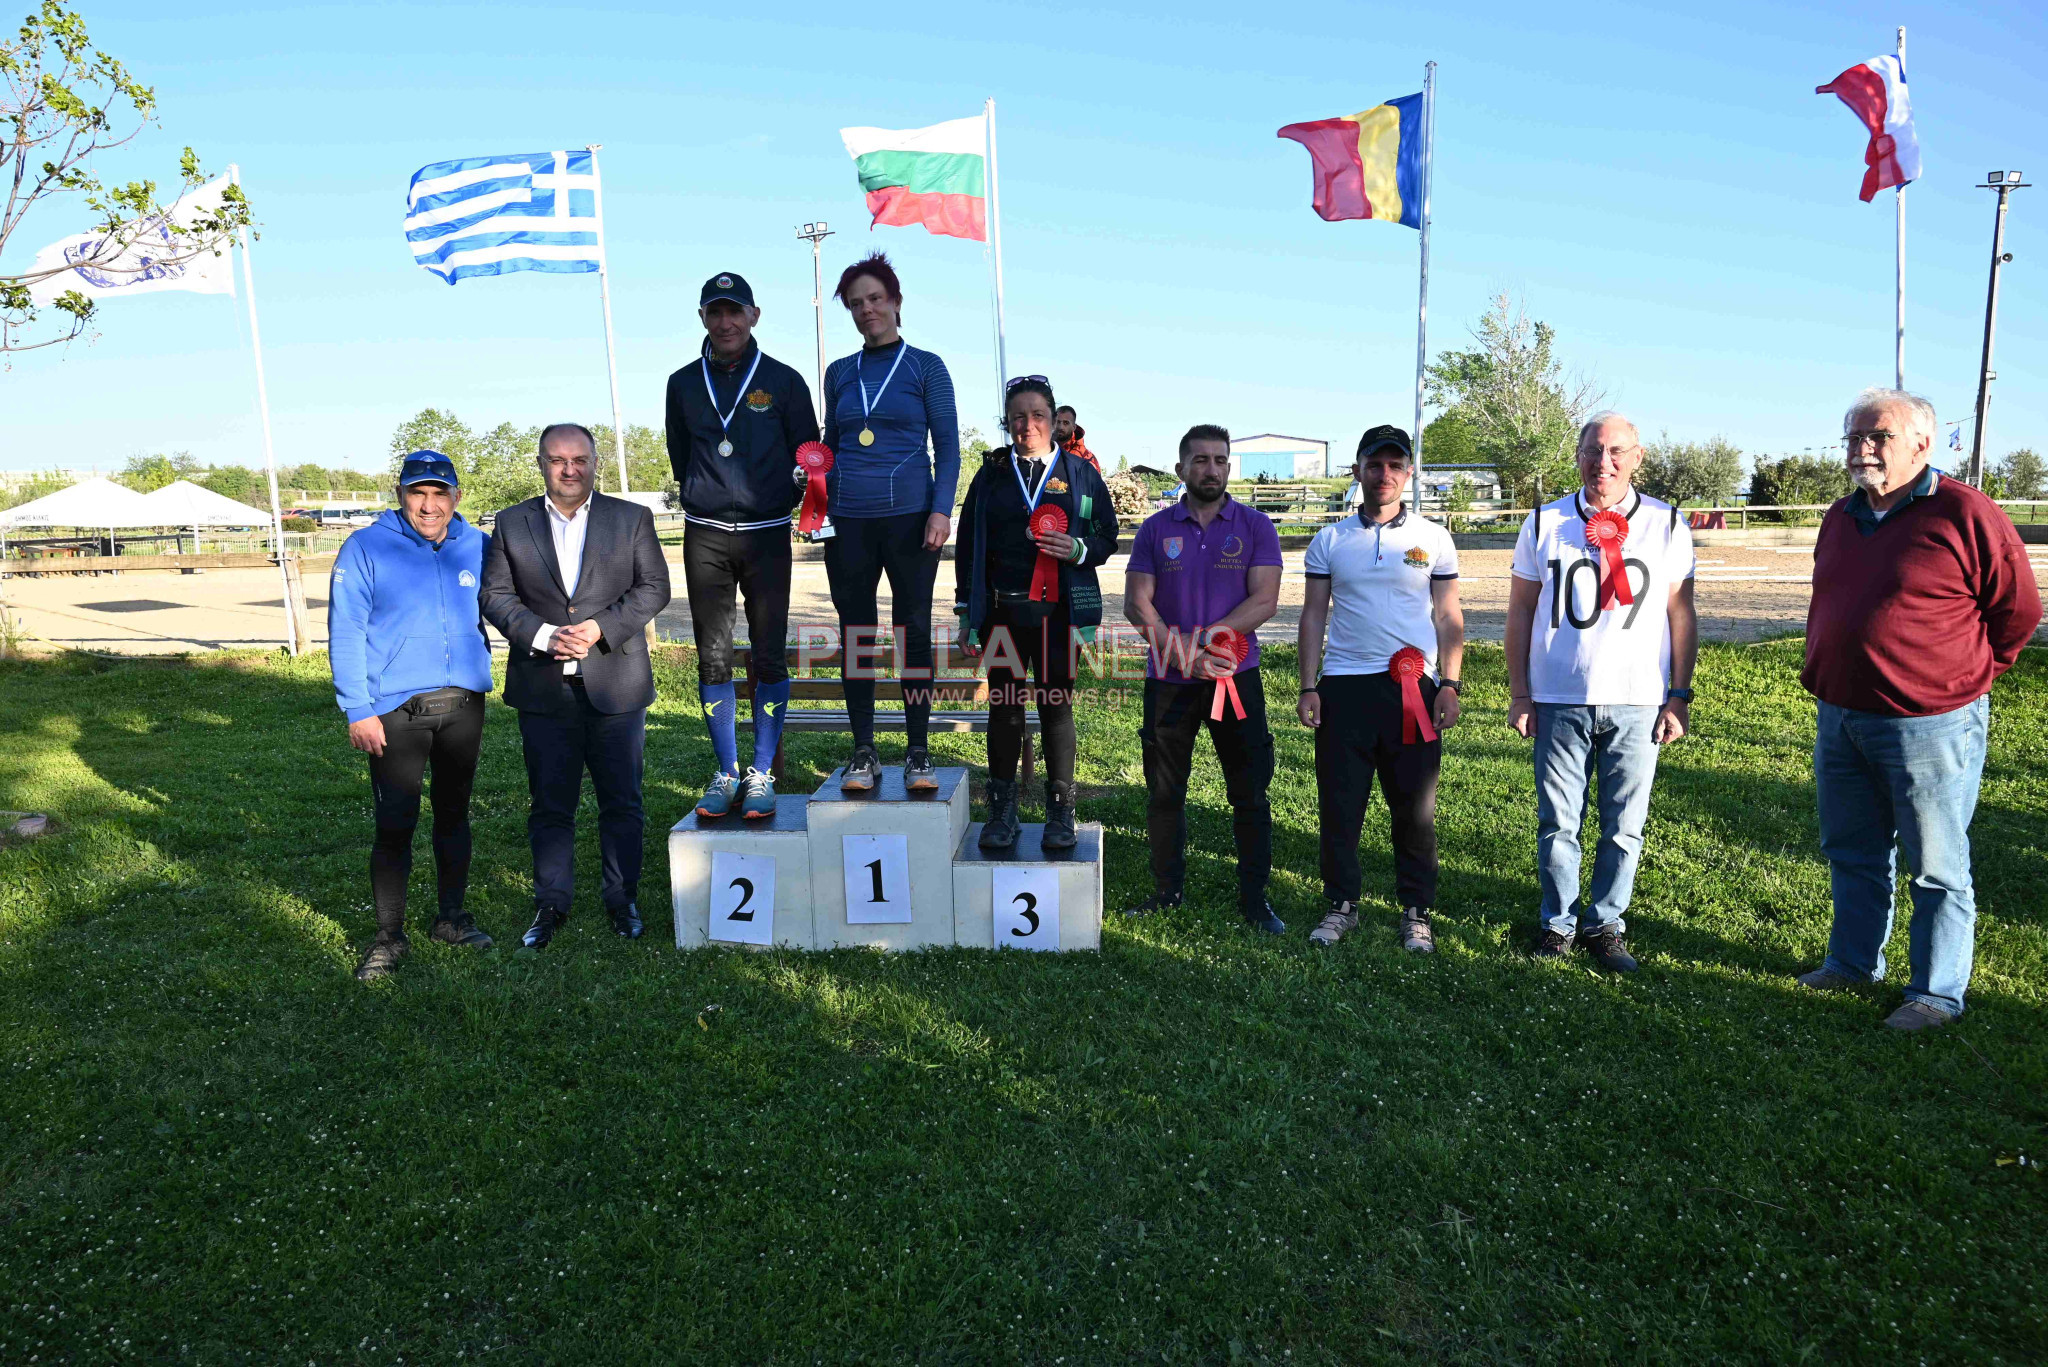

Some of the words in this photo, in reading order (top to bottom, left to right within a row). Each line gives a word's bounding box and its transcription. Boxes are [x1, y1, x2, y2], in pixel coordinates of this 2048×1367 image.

[1547, 558, 1651, 630] 109
[726, 876, 756, 923] 2
[864, 858, 891, 904] 1
[1010, 891, 1041, 938] 3
